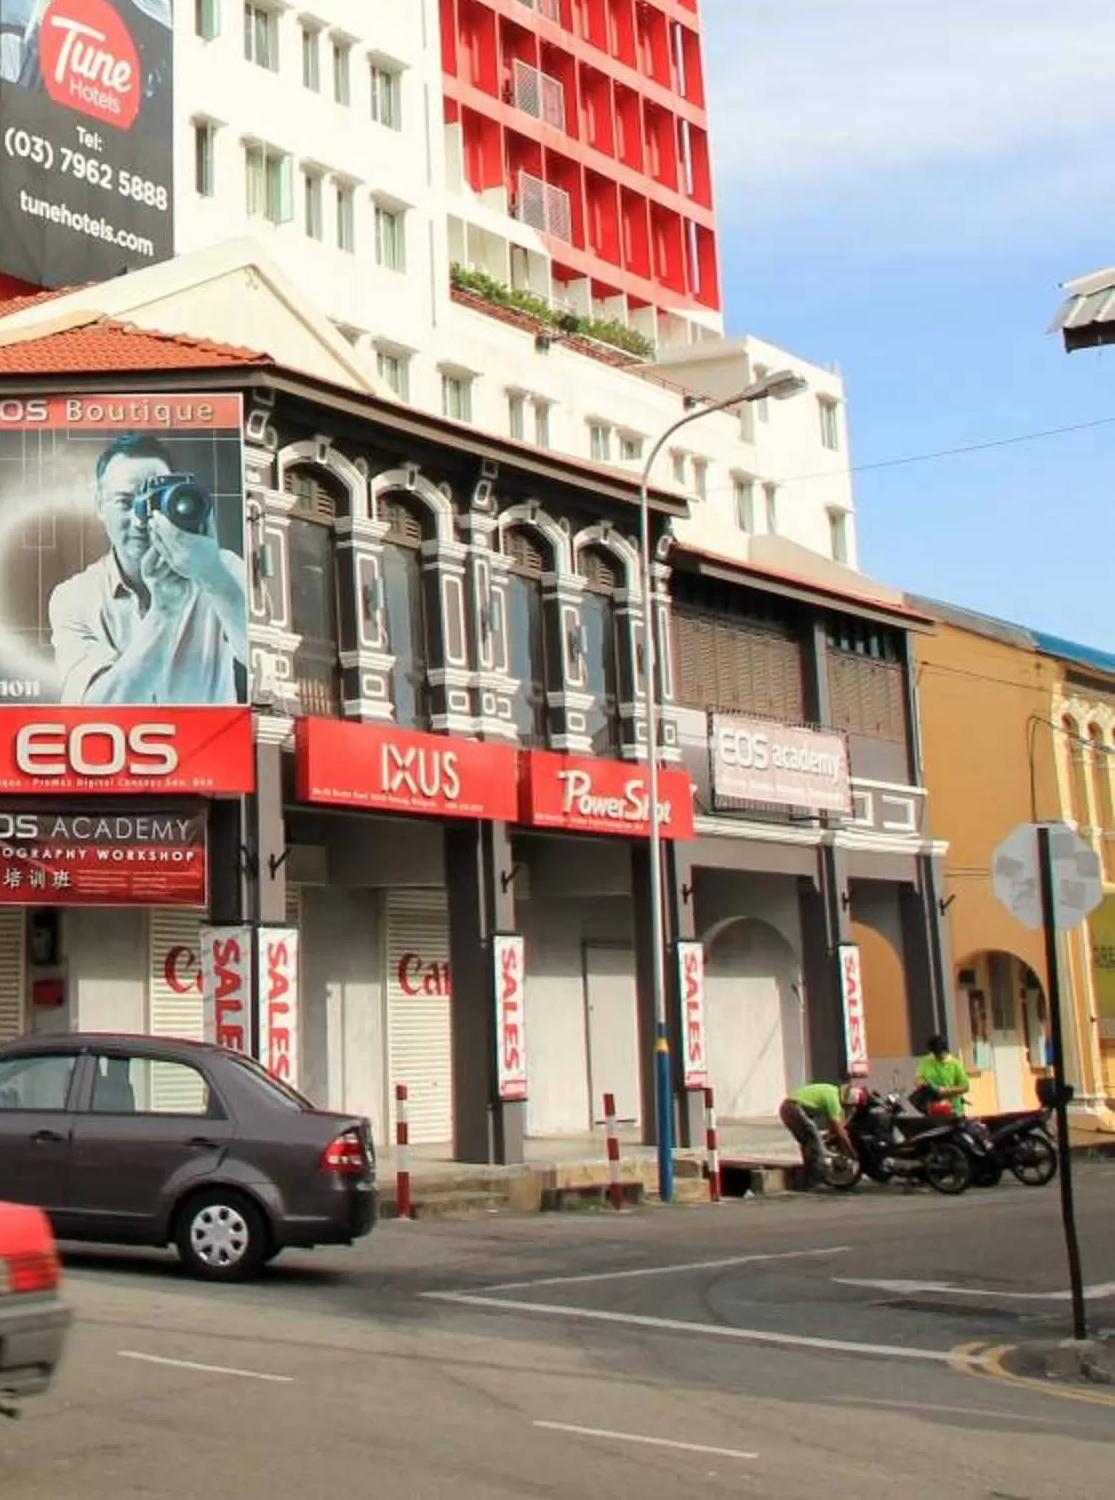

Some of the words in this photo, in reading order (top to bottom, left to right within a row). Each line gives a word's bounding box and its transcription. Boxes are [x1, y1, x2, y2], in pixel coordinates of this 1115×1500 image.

[50, 14, 132, 93] Tune
[69, 78, 121, 116] Hotels
[4, 127, 53, 169] (03)
[60, 148, 113, 190] 7962
[118, 171, 168, 211] 5888
[76, 126, 102, 152] Tel:
[20, 190, 154, 257] tunehotels.com
[66, 399, 215, 425] Boutique
[16, 723, 178, 776] EOS
[381, 743, 460, 800] IXUS
[719, 727, 769, 770] EOS
[772, 740, 840, 785] academy
[50, 817, 190, 841] ACADEMY
[97, 850, 194, 863] WORKSHOP
[213, 938, 244, 1056] SALE
[267, 940, 290, 1080] SALES
[501, 947, 519, 1070] SALES
[685, 951, 702, 1062] SALES
[845, 954, 862, 1053] SALES
